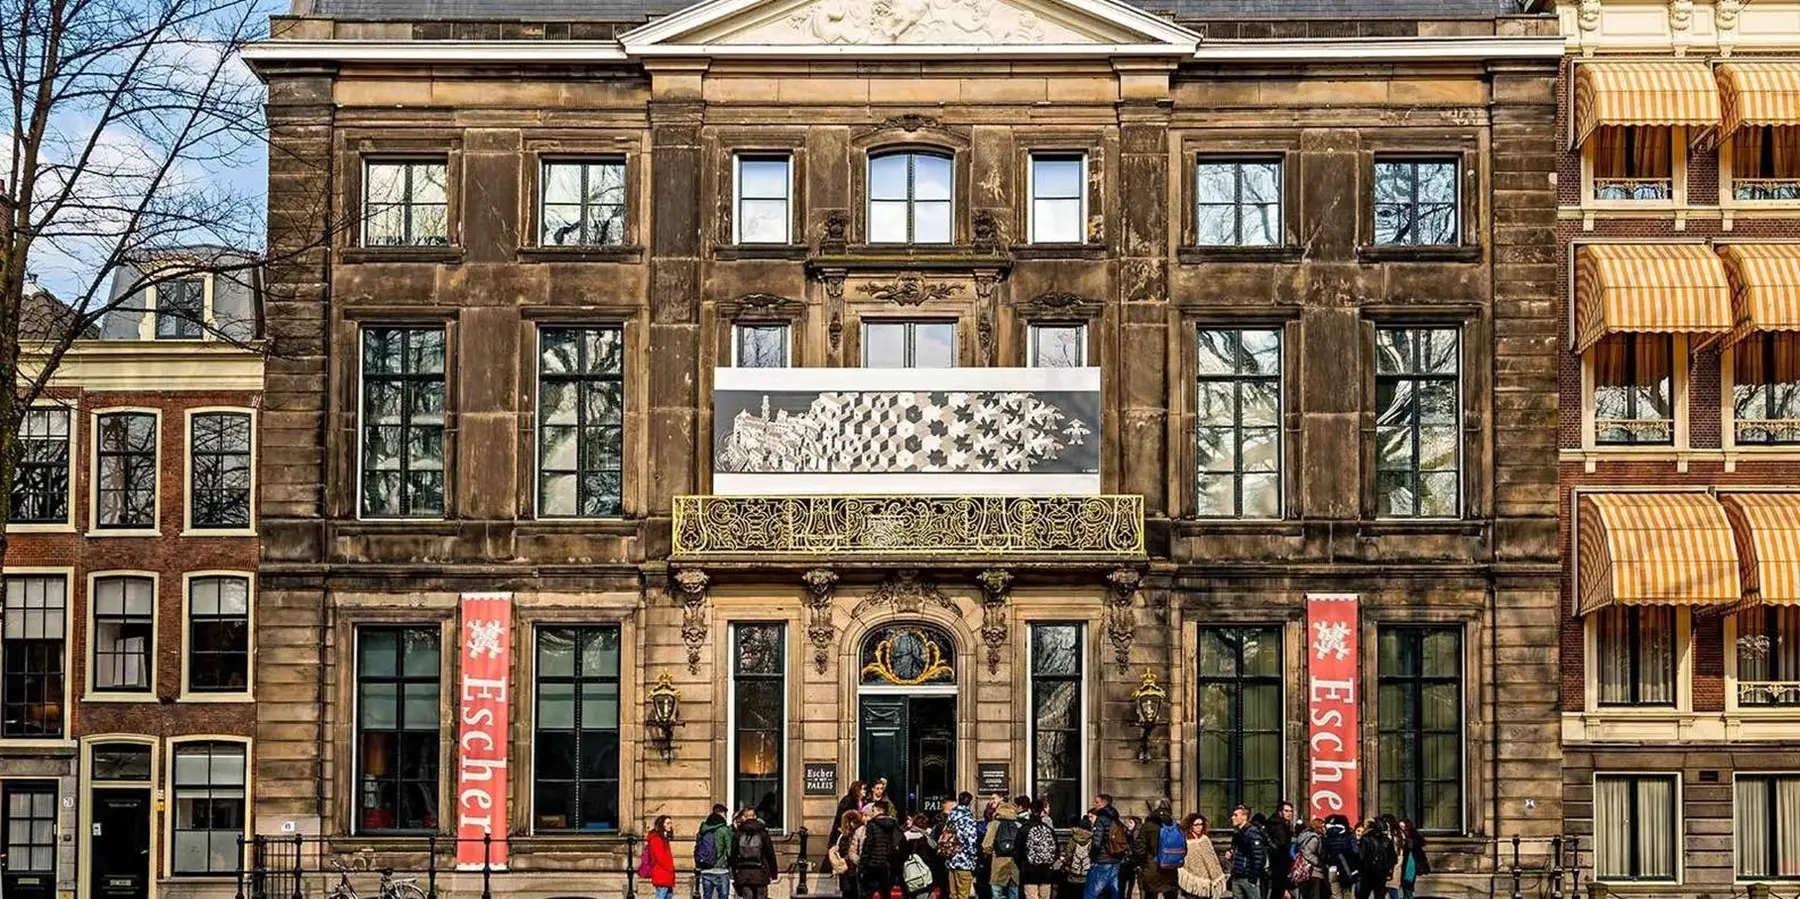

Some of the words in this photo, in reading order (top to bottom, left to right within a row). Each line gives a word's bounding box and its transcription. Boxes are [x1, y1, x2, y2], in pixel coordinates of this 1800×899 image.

[460, 674, 507, 834] Escher
[807, 768, 834, 778] Escher
[1310, 675, 1357, 818] Esche
